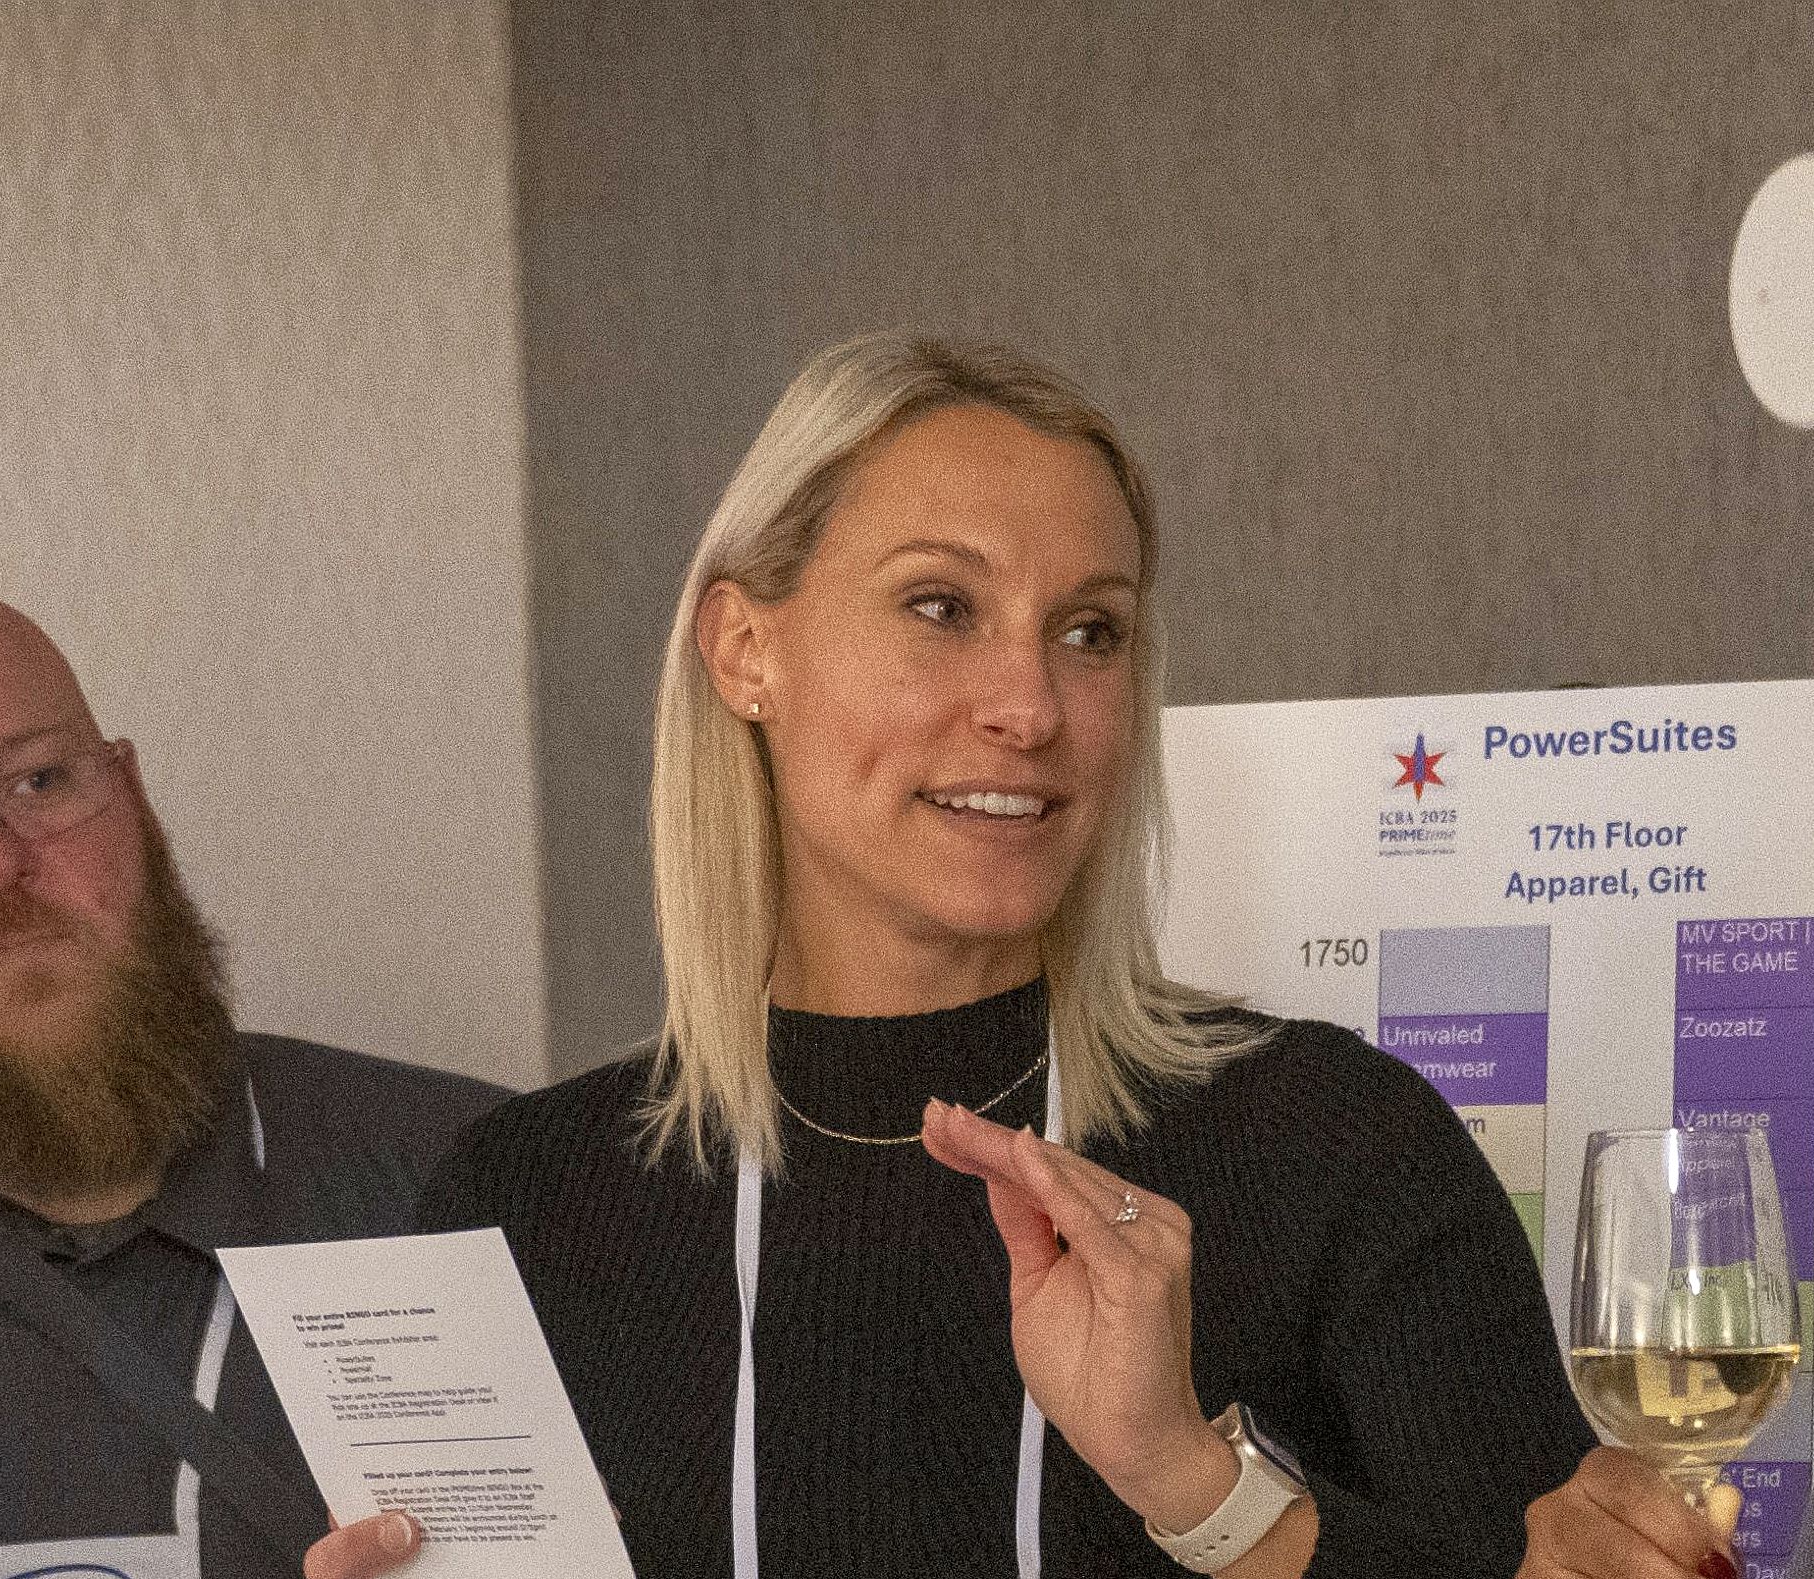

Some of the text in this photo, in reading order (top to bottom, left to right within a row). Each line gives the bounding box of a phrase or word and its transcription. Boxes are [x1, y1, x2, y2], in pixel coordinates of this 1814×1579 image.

[1484, 721, 1738, 761] PowerSuites
[1379, 809, 1457, 825] ICBA 2025
[1528, 820, 1688, 852] 17th Floor
[1504, 867, 1707, 904] Apparel, Gift
[1682, 923, 1715, 945] MV
[1721, 921, 1798, 944] SPORT
[1299, 938, 1368, 968] 1750
[1682, 951, 1798, 975] THE GAME
[1383, 1021, 1484, 1047] Unrivaled
[1680, 1016, 1766, 1039] Zoozatz
[1678, 1109, 1770, 1133] Vantage
[1743, 1468, 1781, 1488] End
